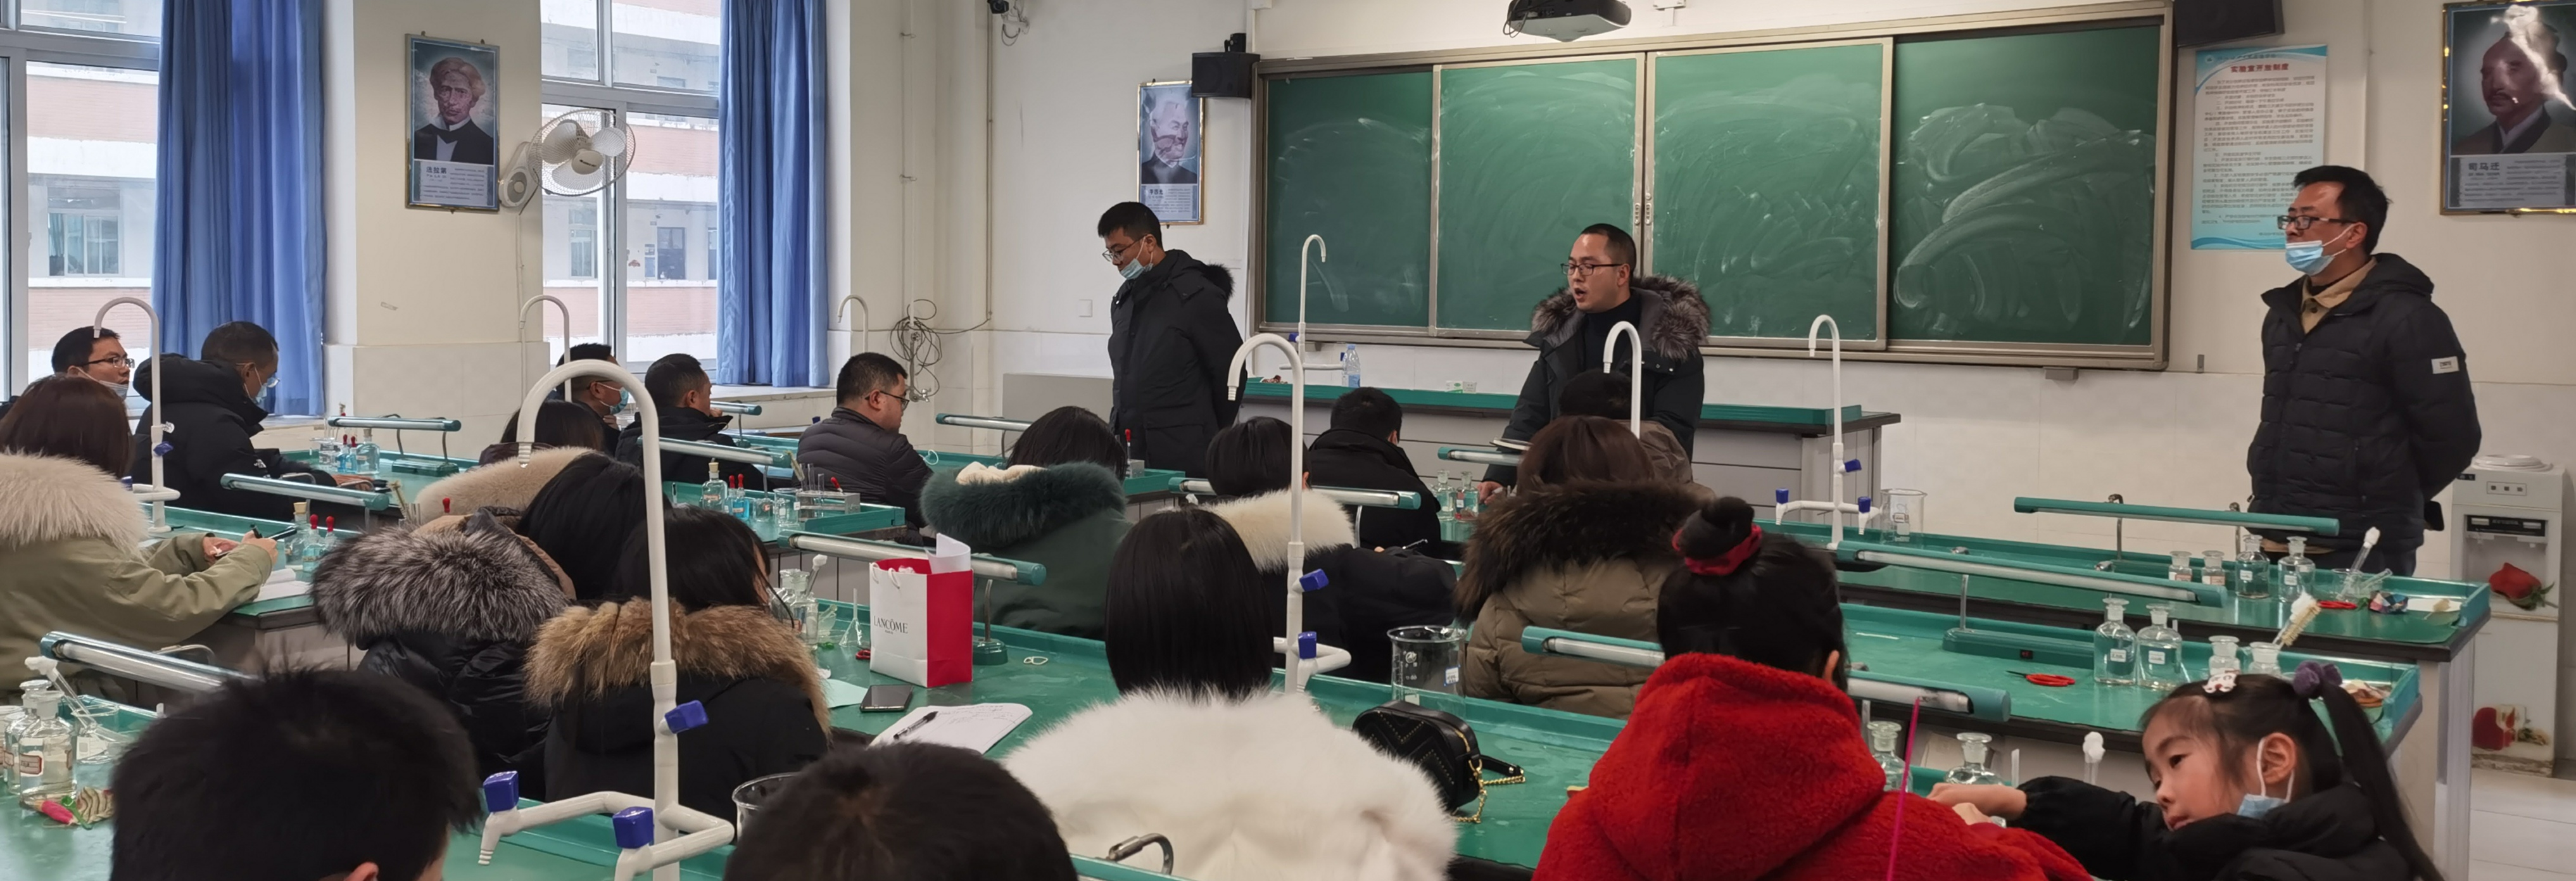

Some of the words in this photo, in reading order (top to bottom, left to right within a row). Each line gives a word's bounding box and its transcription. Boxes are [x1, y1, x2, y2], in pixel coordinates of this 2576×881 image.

[2230, 63, 2289, 73] 实验室开放制度
[2468, 162, 2500, 171] 司马迁
[874, 615, 908, 634] LANCÔME
